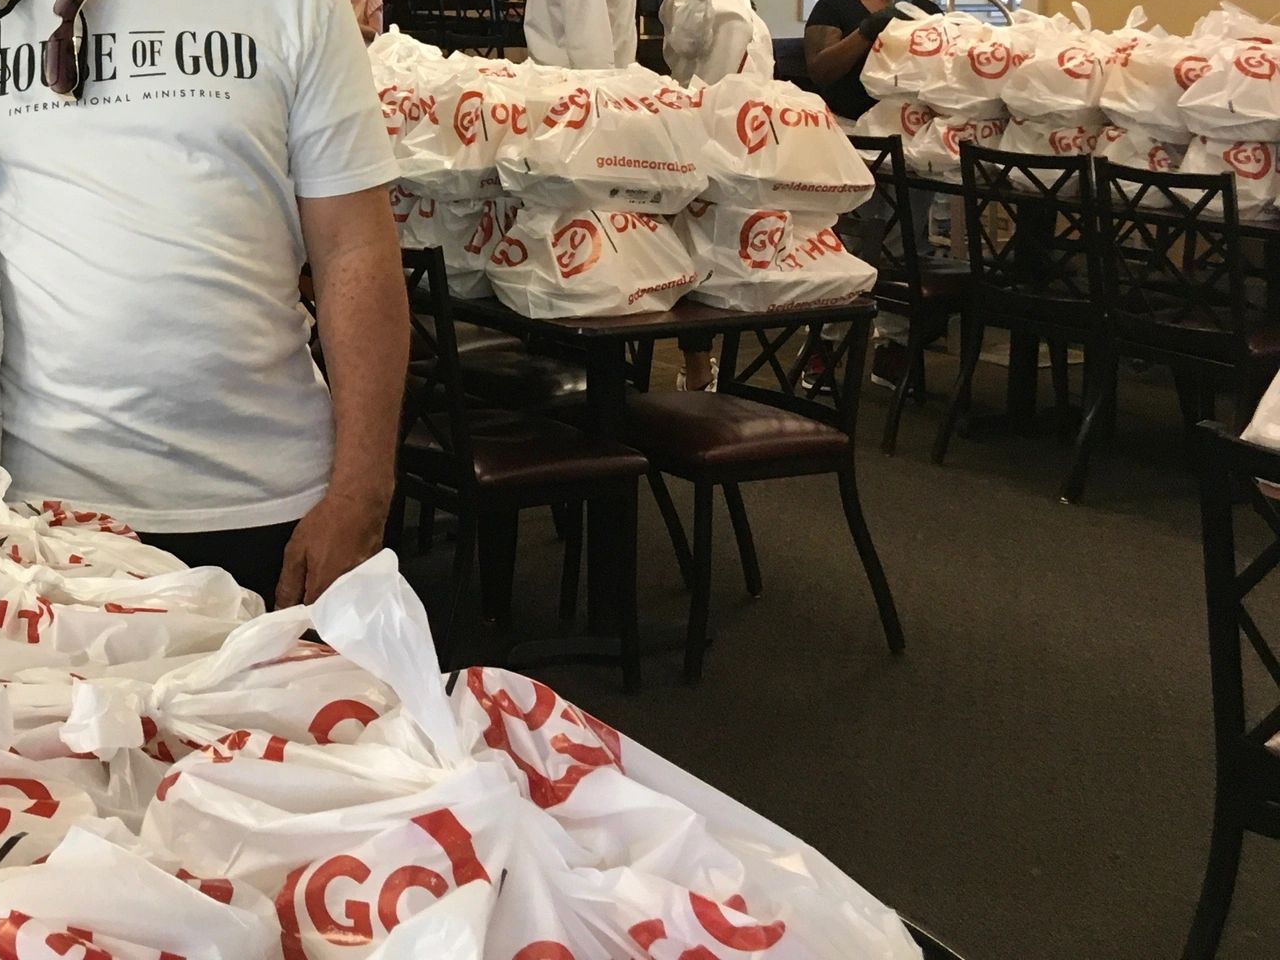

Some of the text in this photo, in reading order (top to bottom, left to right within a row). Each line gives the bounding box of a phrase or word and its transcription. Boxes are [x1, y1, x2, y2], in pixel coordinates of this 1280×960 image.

[131, 39, 163, 68] OF
[175, 30, 258, 80] GOD
[142, 88, 232, 101] MINISTRIES
